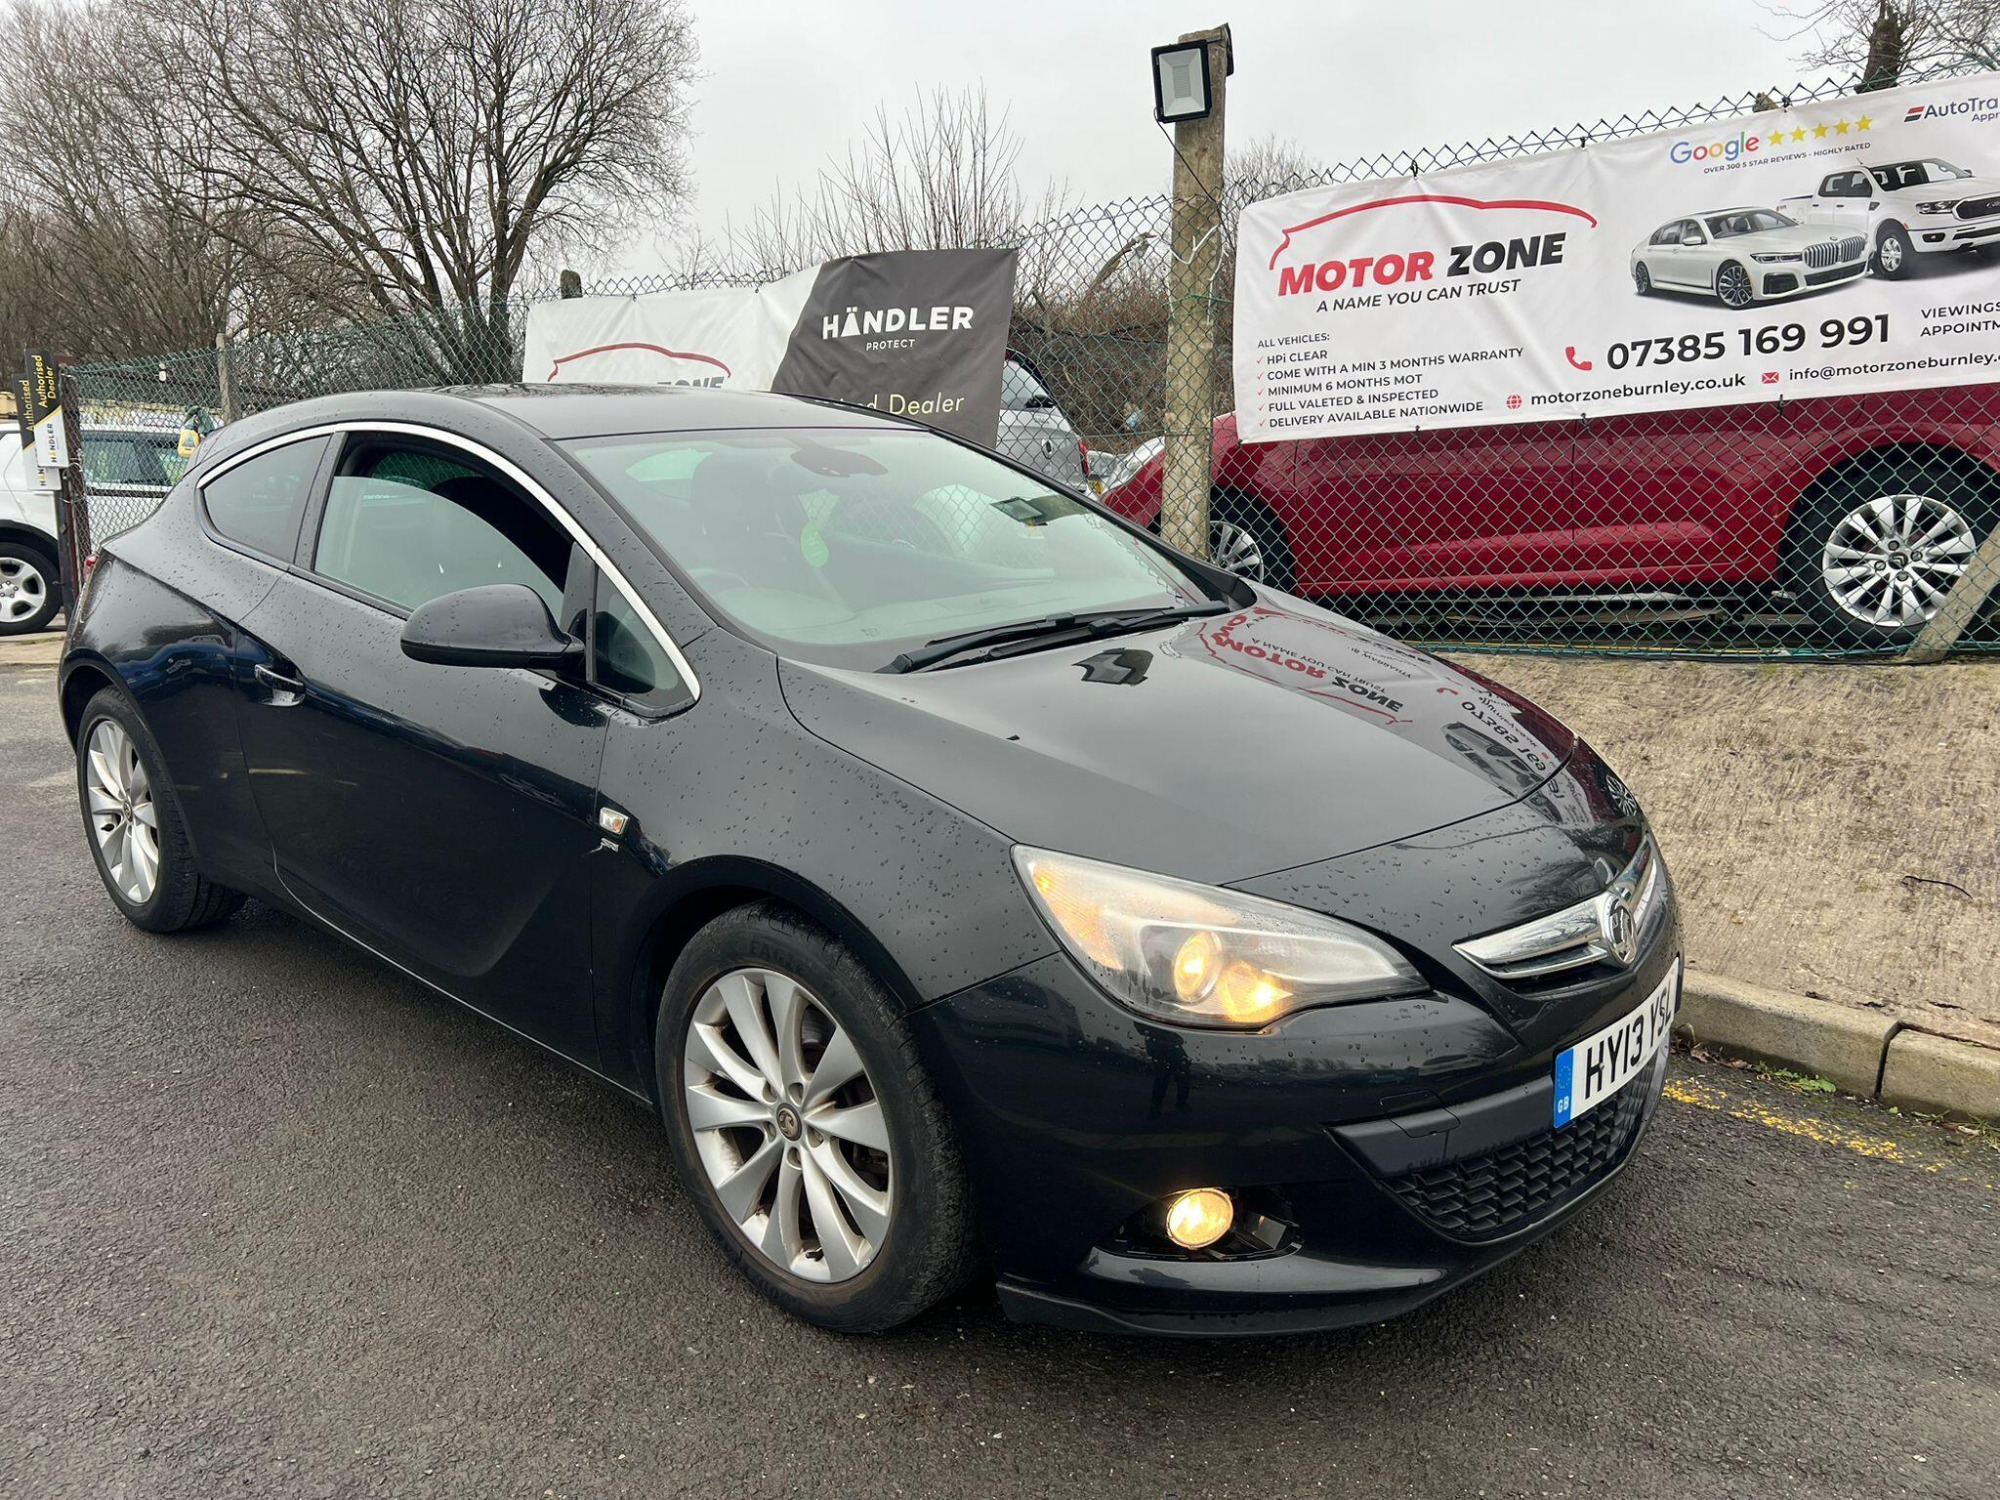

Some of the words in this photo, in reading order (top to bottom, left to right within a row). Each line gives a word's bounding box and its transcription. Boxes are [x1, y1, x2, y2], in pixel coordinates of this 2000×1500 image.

[1669, 131, 1760, 165] Google
[1703, 165, 1725, 174] OVER
[1726, 162, 1741, 171] 300
[1749, 158, 1769, 167] STAR
[1770, 152, 1807, 164] REVIEWS
[1813, 147, 1843, 157] HIGHLY
[1844, 142, 1871, 153] RATED
[1277, 250, 1436, 297] MOTOR
[1446, 232, 1566, 278] ZONE
[1316, 300, 1329, 313] A
[1332, 295, 1383, 312] NAME
[1387, 291, 1423, 307] YOU
[1426, 286, 1463, 302] CAN
[1467, 279, 1522, 298] TRUST
[822, 306, 974, 340] HÄNDLER
[866, 339, 916, 351] PROTECT
[1257, 338, 1276, 349] ALL
[1277, 332, 1330, 346] VEHICLES:
[1607, 331, 1726, 370] 07385
[1738, 323, 1807, 356] 169
[1819, 314, 1890, 349] 991
[1267, 353, 1287, 365] HPi
[1289, 349, 1329, 362] CLEAR
[1267, 368, 1302, 381] COME
[1304, 364, 1337, 377] WITH
[1339, 363, 1349, 374] A
[1351, 361, 1376, 373] MIN
[1379, 360, 1387, 371] 3
[1390, 355, 1445, 369] MONTHS
[1448, 347, 1524, 363] WARRANTY
[1789, 352, 2000, 381] info@motorzoneburnley.
[31, 354, 48, 408] Authorised
[45, 365, 56, 399] Dealer
[1268, 382, 1323, 396] MINIMUM
[1325, 381, 1333, 391] 6
[1336, 376, 1391, 390] MONTHS
[1394, 374, 1423, 386] MOT
[1531, 373, 1746, 406] motorzoneburnley.co.uk
[889, 391, 965, 416] Dealer
[1268, 400, 1297, 412] FULL
[1299, 395, 1353, 409] VALETED
[1356, 395, 1365, 405] &
[1368, 389, 1439, 404] INSPECTED
[1269, 414, 1325, 428] DELIVERY
[1327, 408, 1396, 423] AVAILABLE
[1399, 401, 1484, 417] NATIONWIDE
[1585, 1014, 1645, 1100] HY13
[1650, 980, 1673, 1049] YSL
[1557, 1095, 1570, 1114] GB
